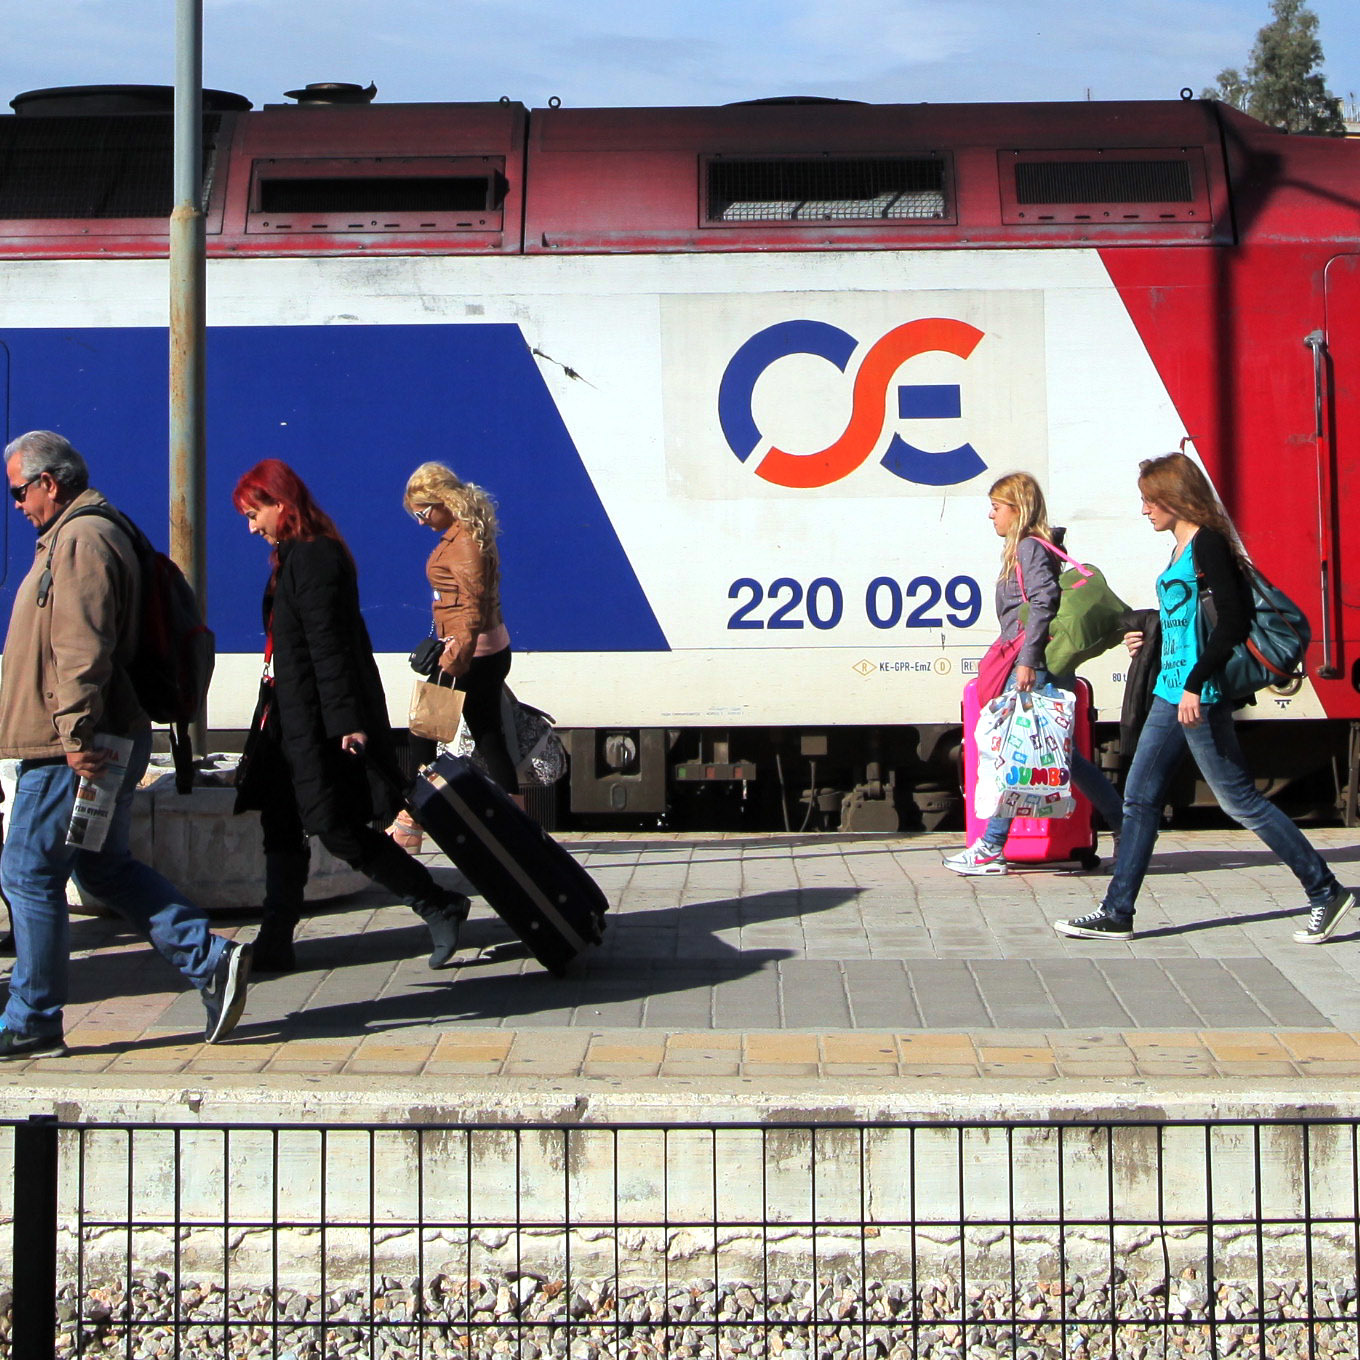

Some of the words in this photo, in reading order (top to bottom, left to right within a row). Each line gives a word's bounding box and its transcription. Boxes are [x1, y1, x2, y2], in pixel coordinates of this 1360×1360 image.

[727, 577, 843, 630] 220
[865, 575, 982, 629] 029
[879, 661, 931, 672] KE-GPR-EmZ
[1112, 672, 1122, 682] 80
[1006, 765, 1070, 787] JUMBO
